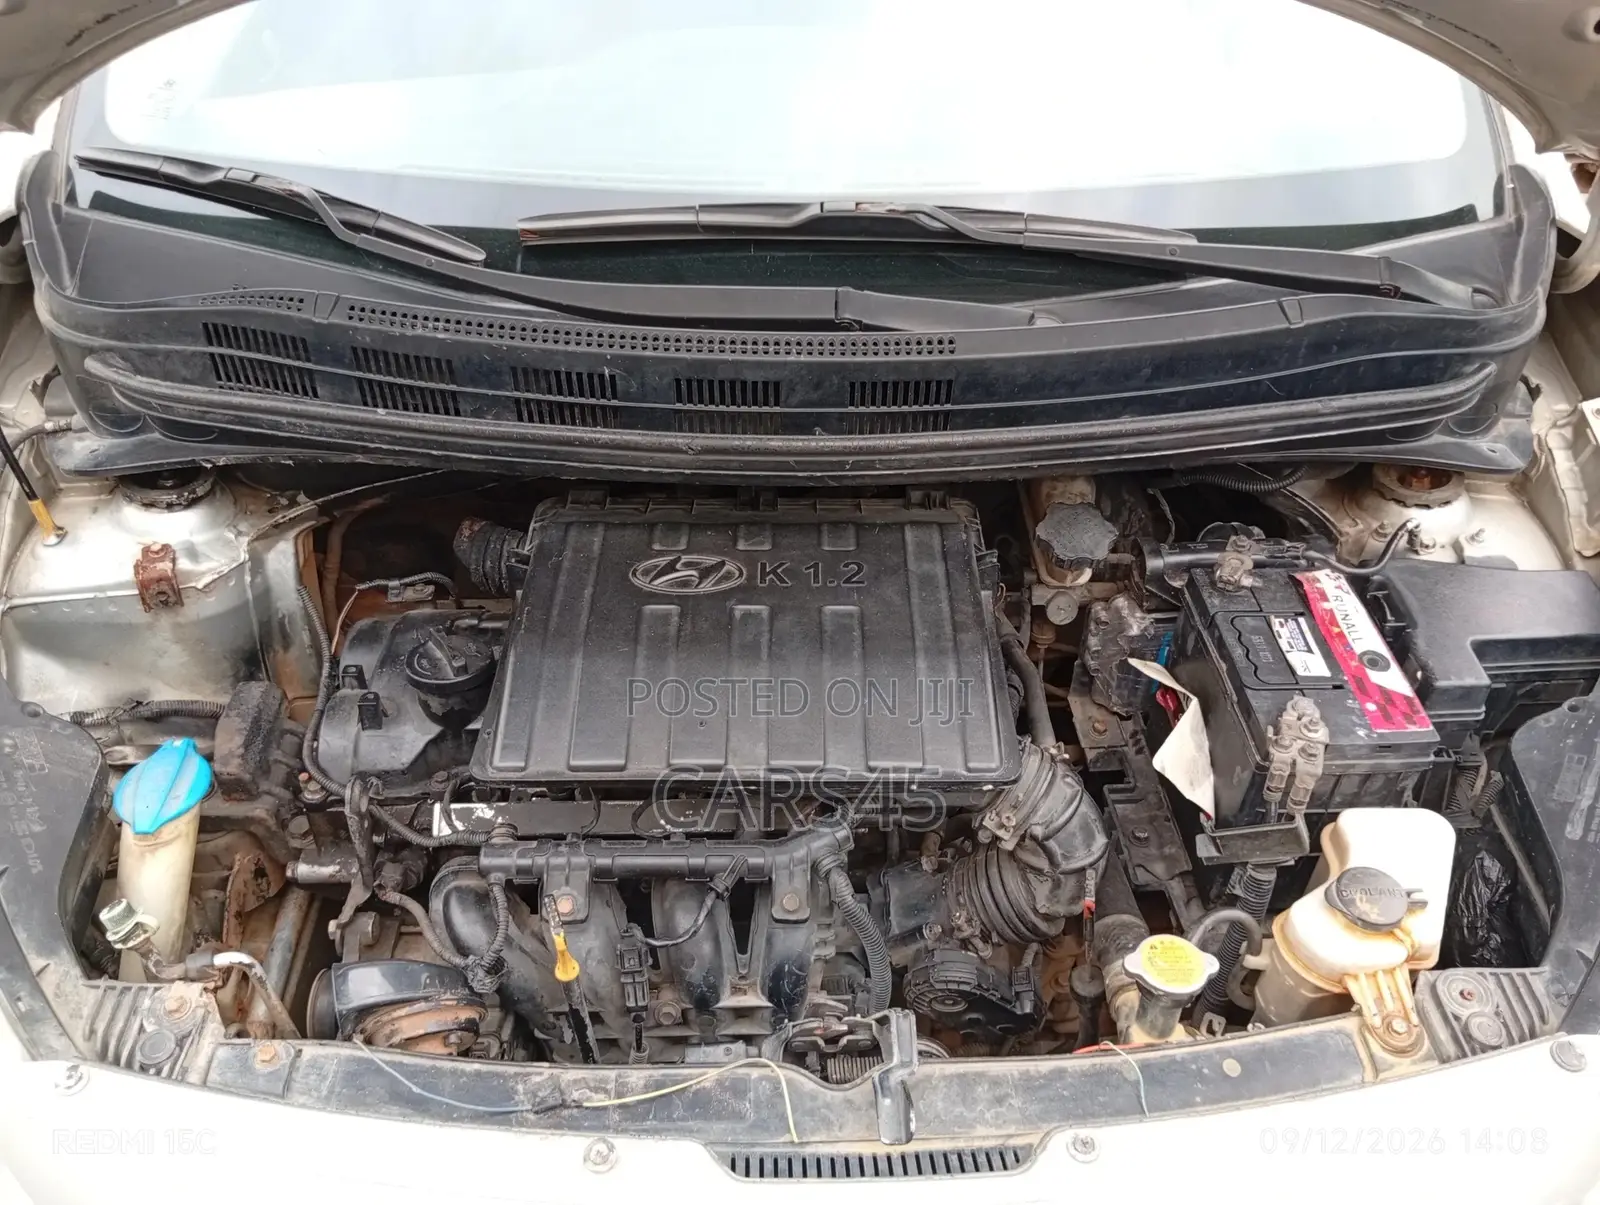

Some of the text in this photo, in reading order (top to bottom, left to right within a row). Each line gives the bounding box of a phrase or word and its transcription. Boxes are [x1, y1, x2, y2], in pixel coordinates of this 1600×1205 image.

[756, 560, 867, 588] K 1.2
[1332, 594, 1364, 644] RUNALL
[1339, 886, 1404, 899] COOLANT
